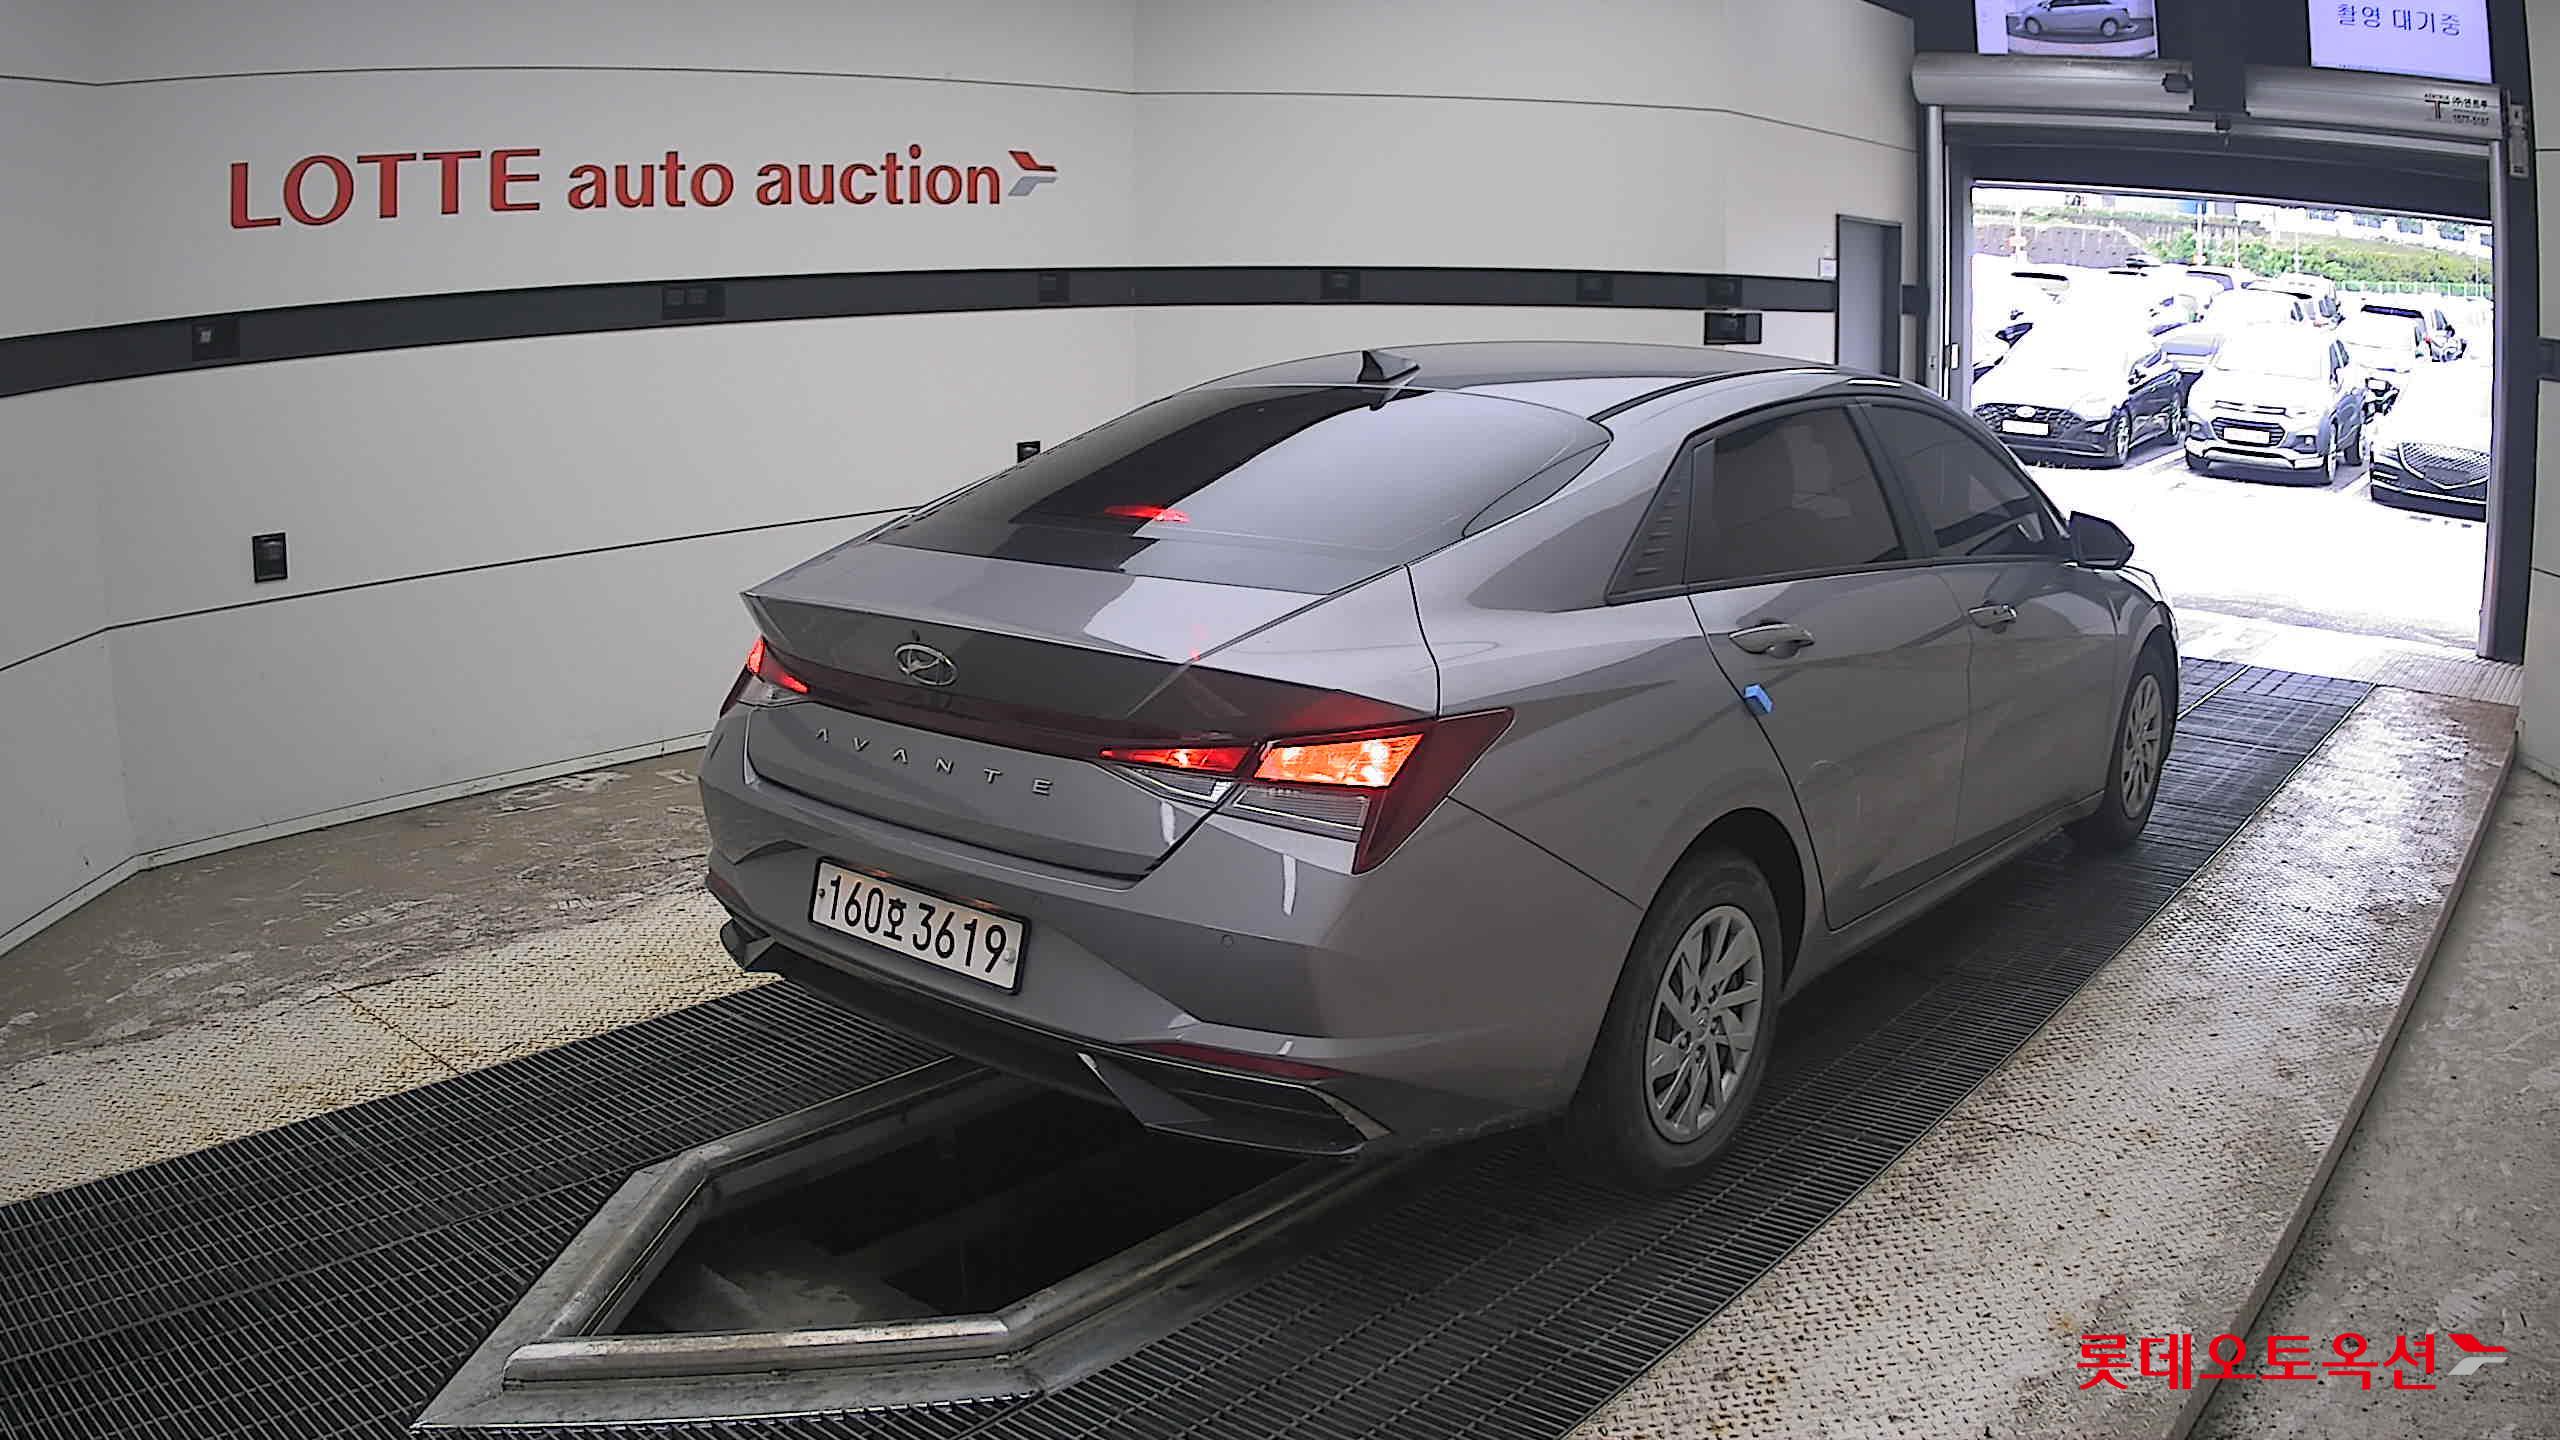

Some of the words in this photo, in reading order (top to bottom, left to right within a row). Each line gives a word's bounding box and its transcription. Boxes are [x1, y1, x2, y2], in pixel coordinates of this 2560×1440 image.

[2337, 3, 2381, 28] 촬영
[2392, 8, 2460, 36] 대기중
[229, 148, 541, 230] LOTTE
[567, 150, 735, 210] auto
[755, 144, 1002, 206] auction
[815, 726, 1054, 796] AVANTE
